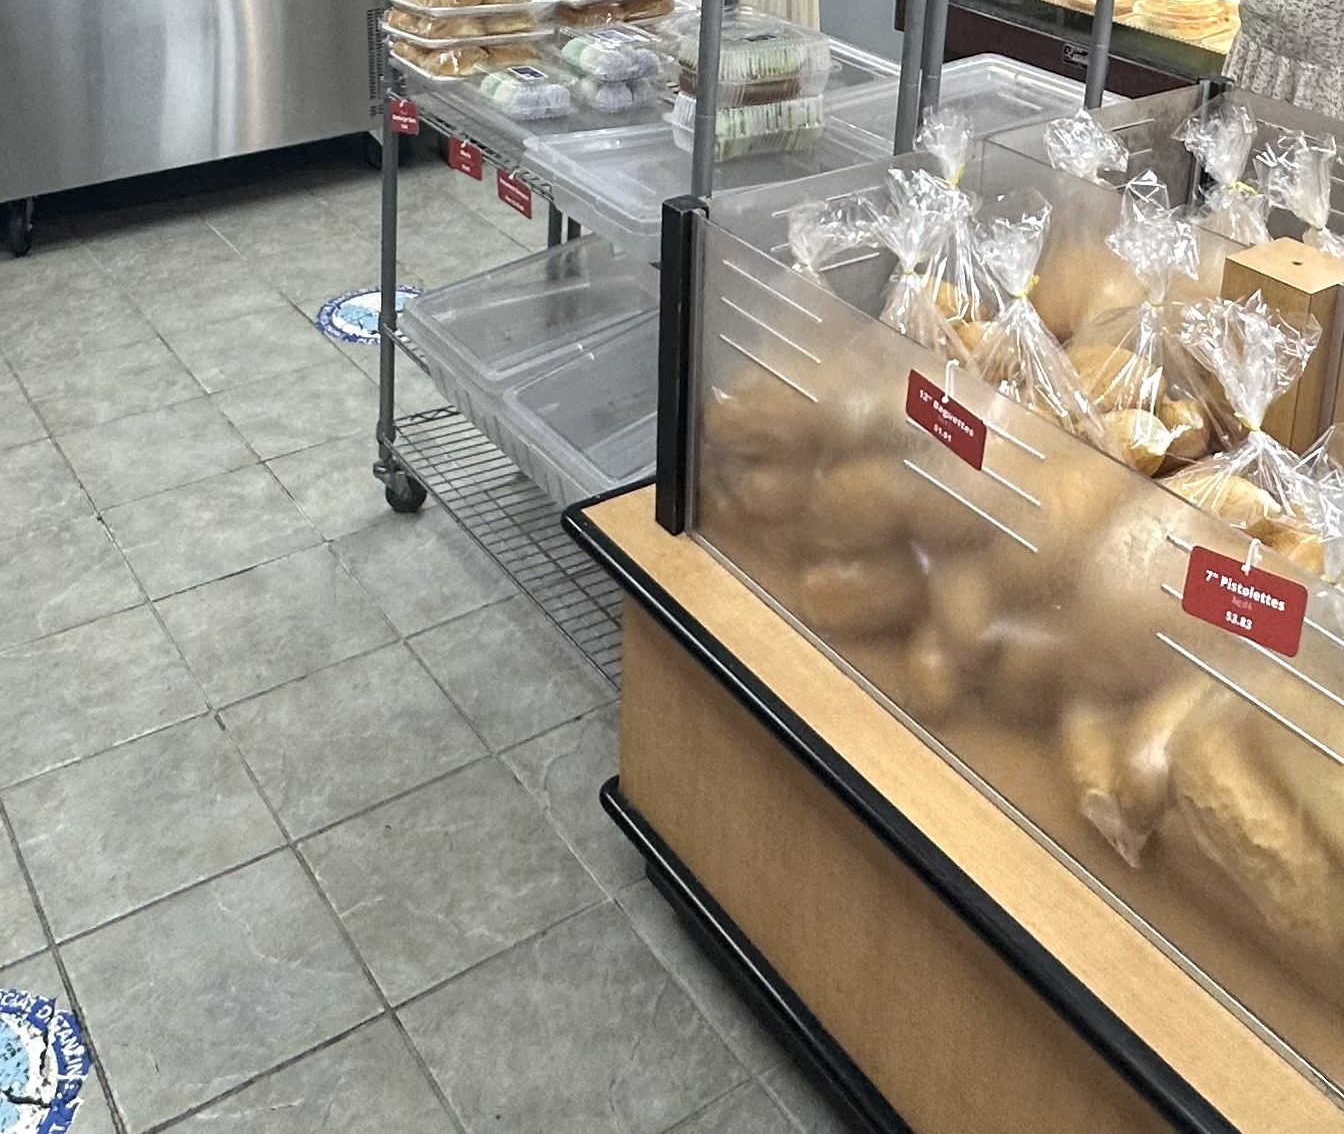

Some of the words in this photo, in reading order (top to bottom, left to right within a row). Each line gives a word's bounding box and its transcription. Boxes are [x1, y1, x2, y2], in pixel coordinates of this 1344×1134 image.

[933, 399, 975, 437] Baguettes
[1205, 569, 1218, 582] 7"
[1219, 575, 1286, 612] Pistolettes
